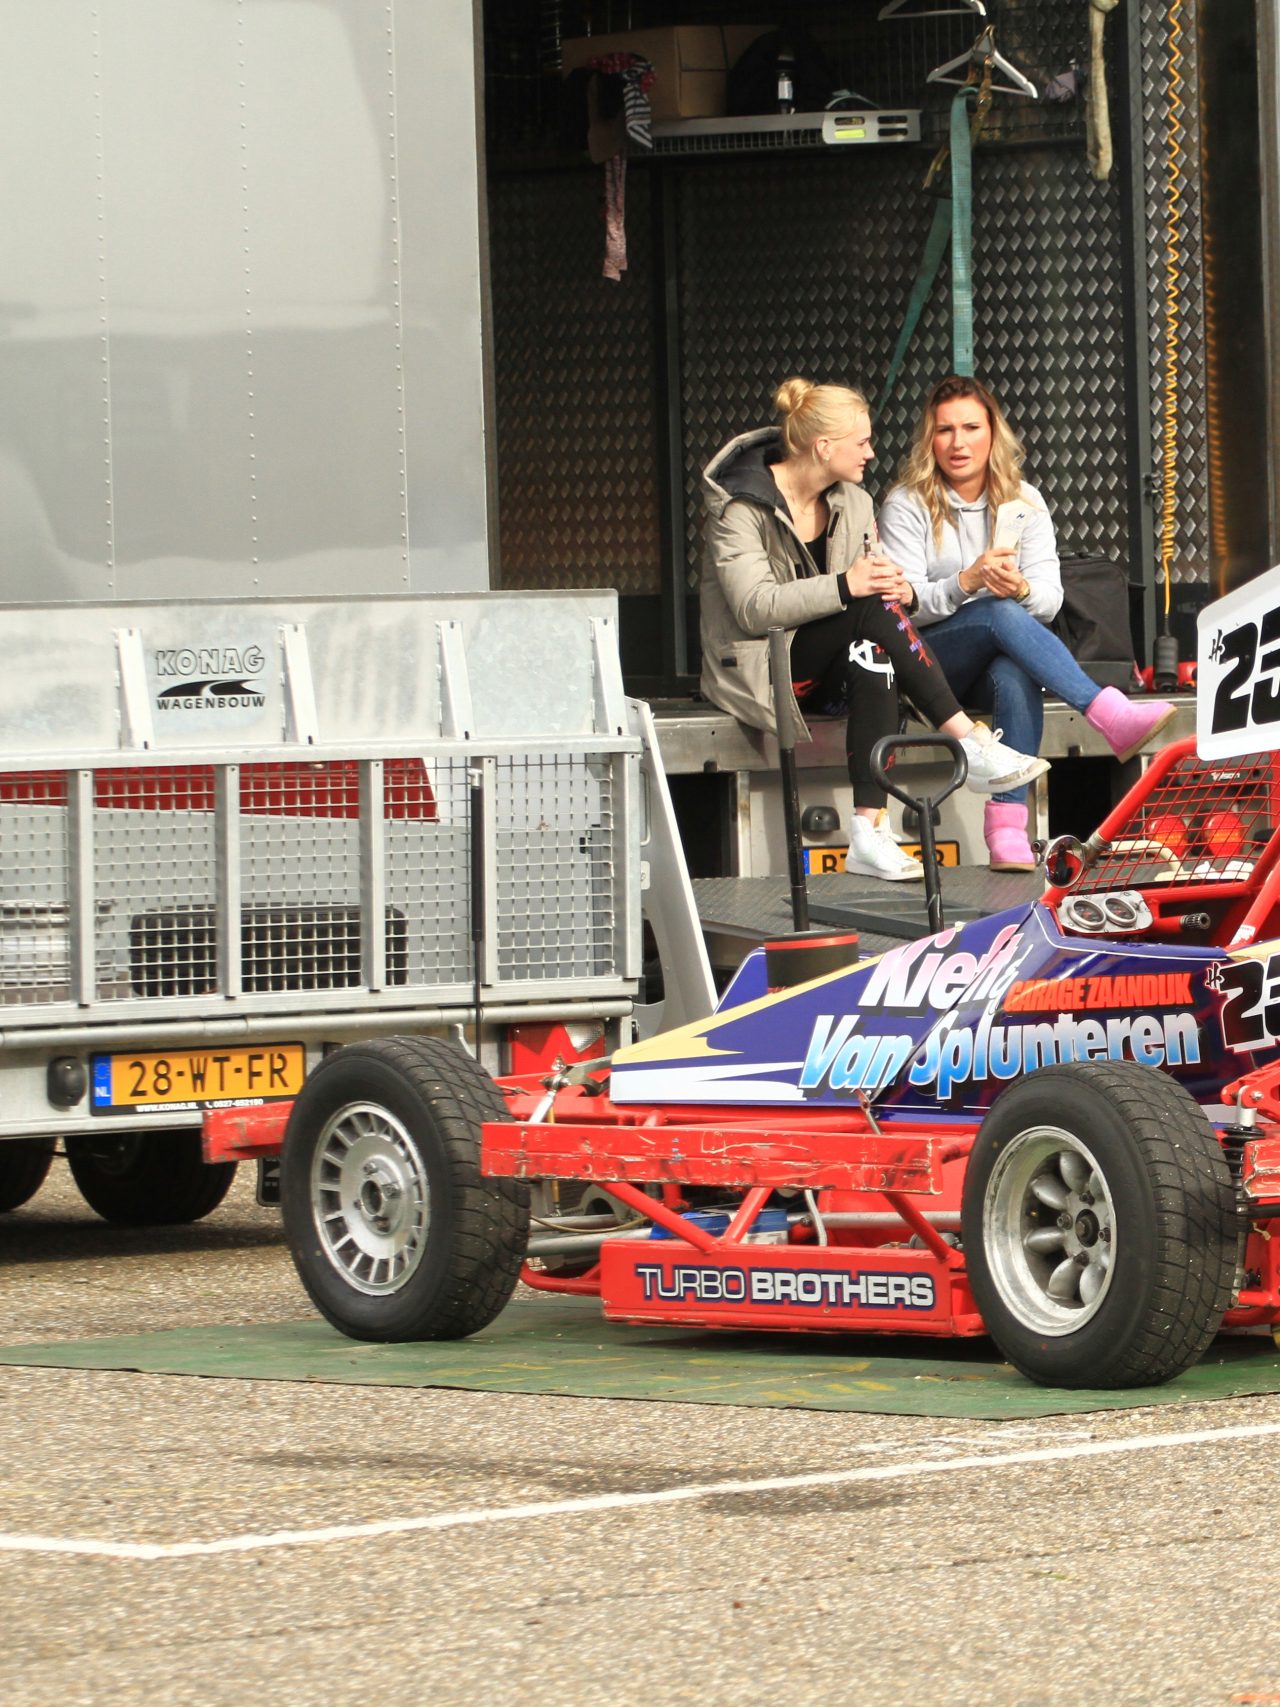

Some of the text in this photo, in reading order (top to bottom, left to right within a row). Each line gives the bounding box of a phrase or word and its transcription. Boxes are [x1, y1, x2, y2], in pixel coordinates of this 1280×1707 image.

[156, 645, 265, 676] KONAG
[157, 696, 266, 710] WAGENBOUW
[858, 925, 1024, 1010] Kieft
[1004, 977, 1090, 1012] GARAGE
[798, 1004, 1201, 1100] Van Splunteren
[95, 1087, 110, 1098] NL
[128, 1052, 289, 1098] 28-WT-FR
[637, 1268, 935, 1306] TURBO BROTHERS
